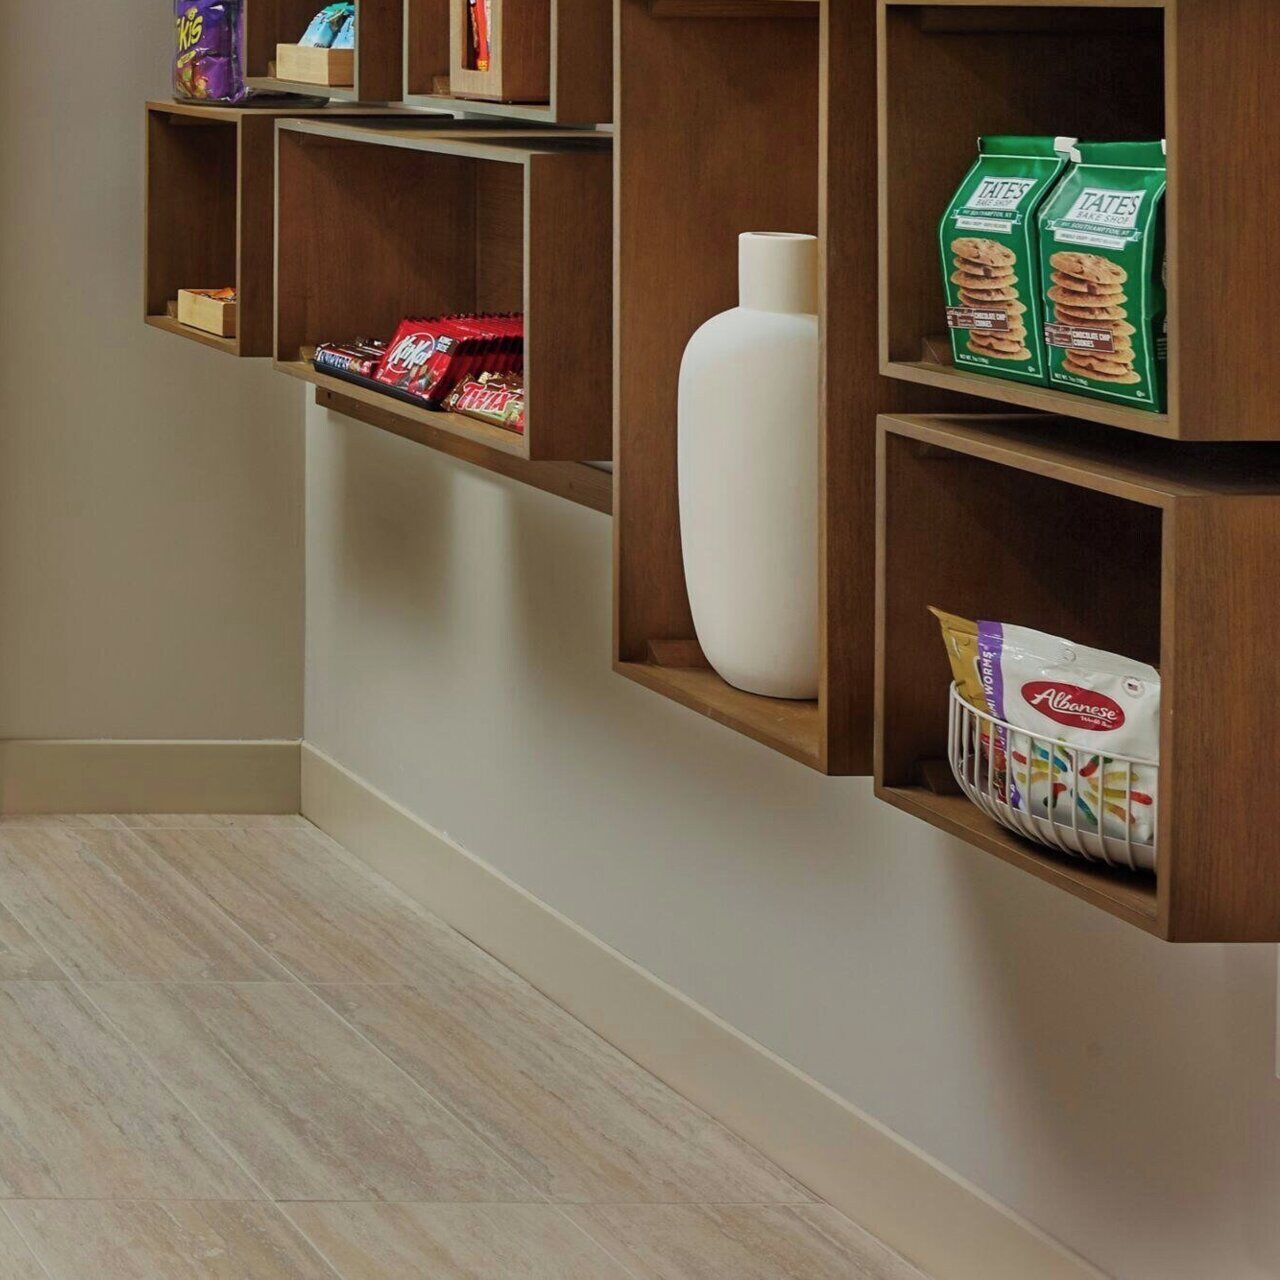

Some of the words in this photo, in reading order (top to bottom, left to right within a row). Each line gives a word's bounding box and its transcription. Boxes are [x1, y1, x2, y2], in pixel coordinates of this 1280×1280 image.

[978, 181, 1030, 199] TATE'S
[1079, 192, 1139, 215] TATE'S
[1076, 211, 1102, 220] BAKE
[1105, 214, 1133, 225] SHOP
[983, 651, 994, 695] WORMS
[1031, 688, 1118, 722] Albanese
